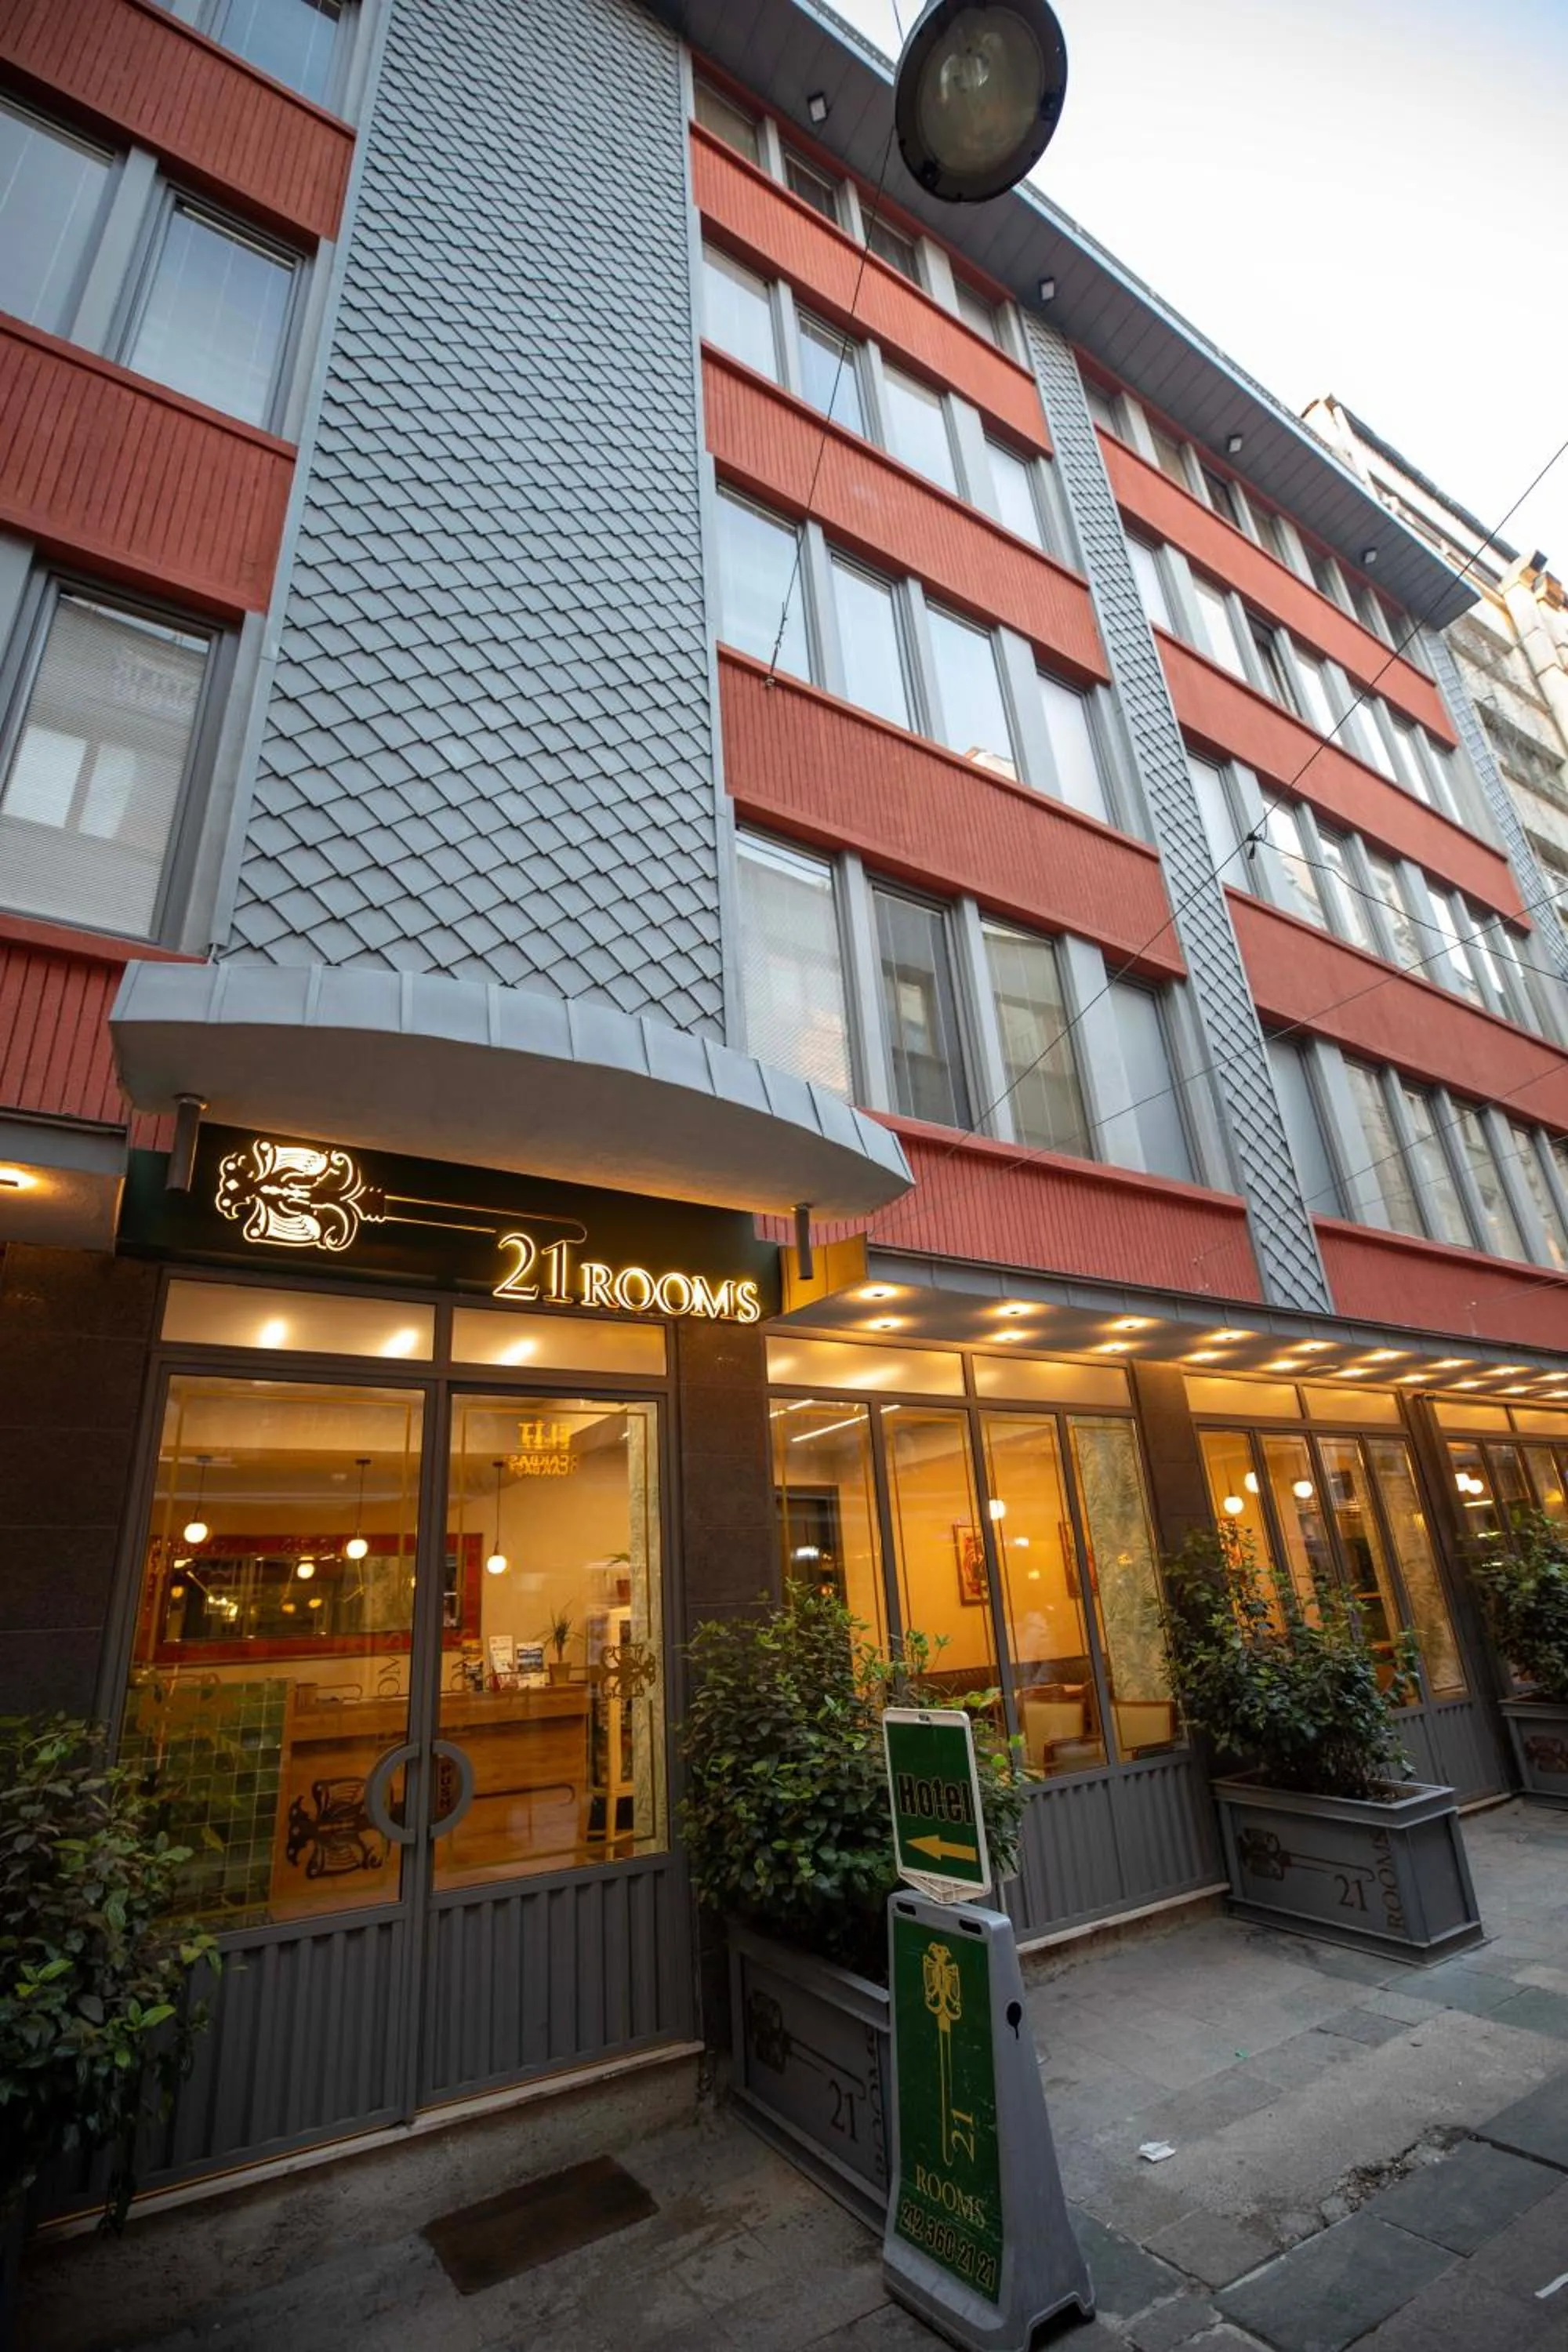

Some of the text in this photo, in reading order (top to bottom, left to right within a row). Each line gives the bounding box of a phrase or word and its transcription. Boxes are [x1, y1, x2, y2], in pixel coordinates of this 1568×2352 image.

[492, 1232, 761, 1323] 21 ROOMS
[897, 1773, 977, 1825] Hotel
[1335, 1872, 1368, 1911] 21
[829, 2078, 859, 2143] 21
[916, 2164, 986, 2229] ROOMS
[926, 2216, 956, 2263] 360
